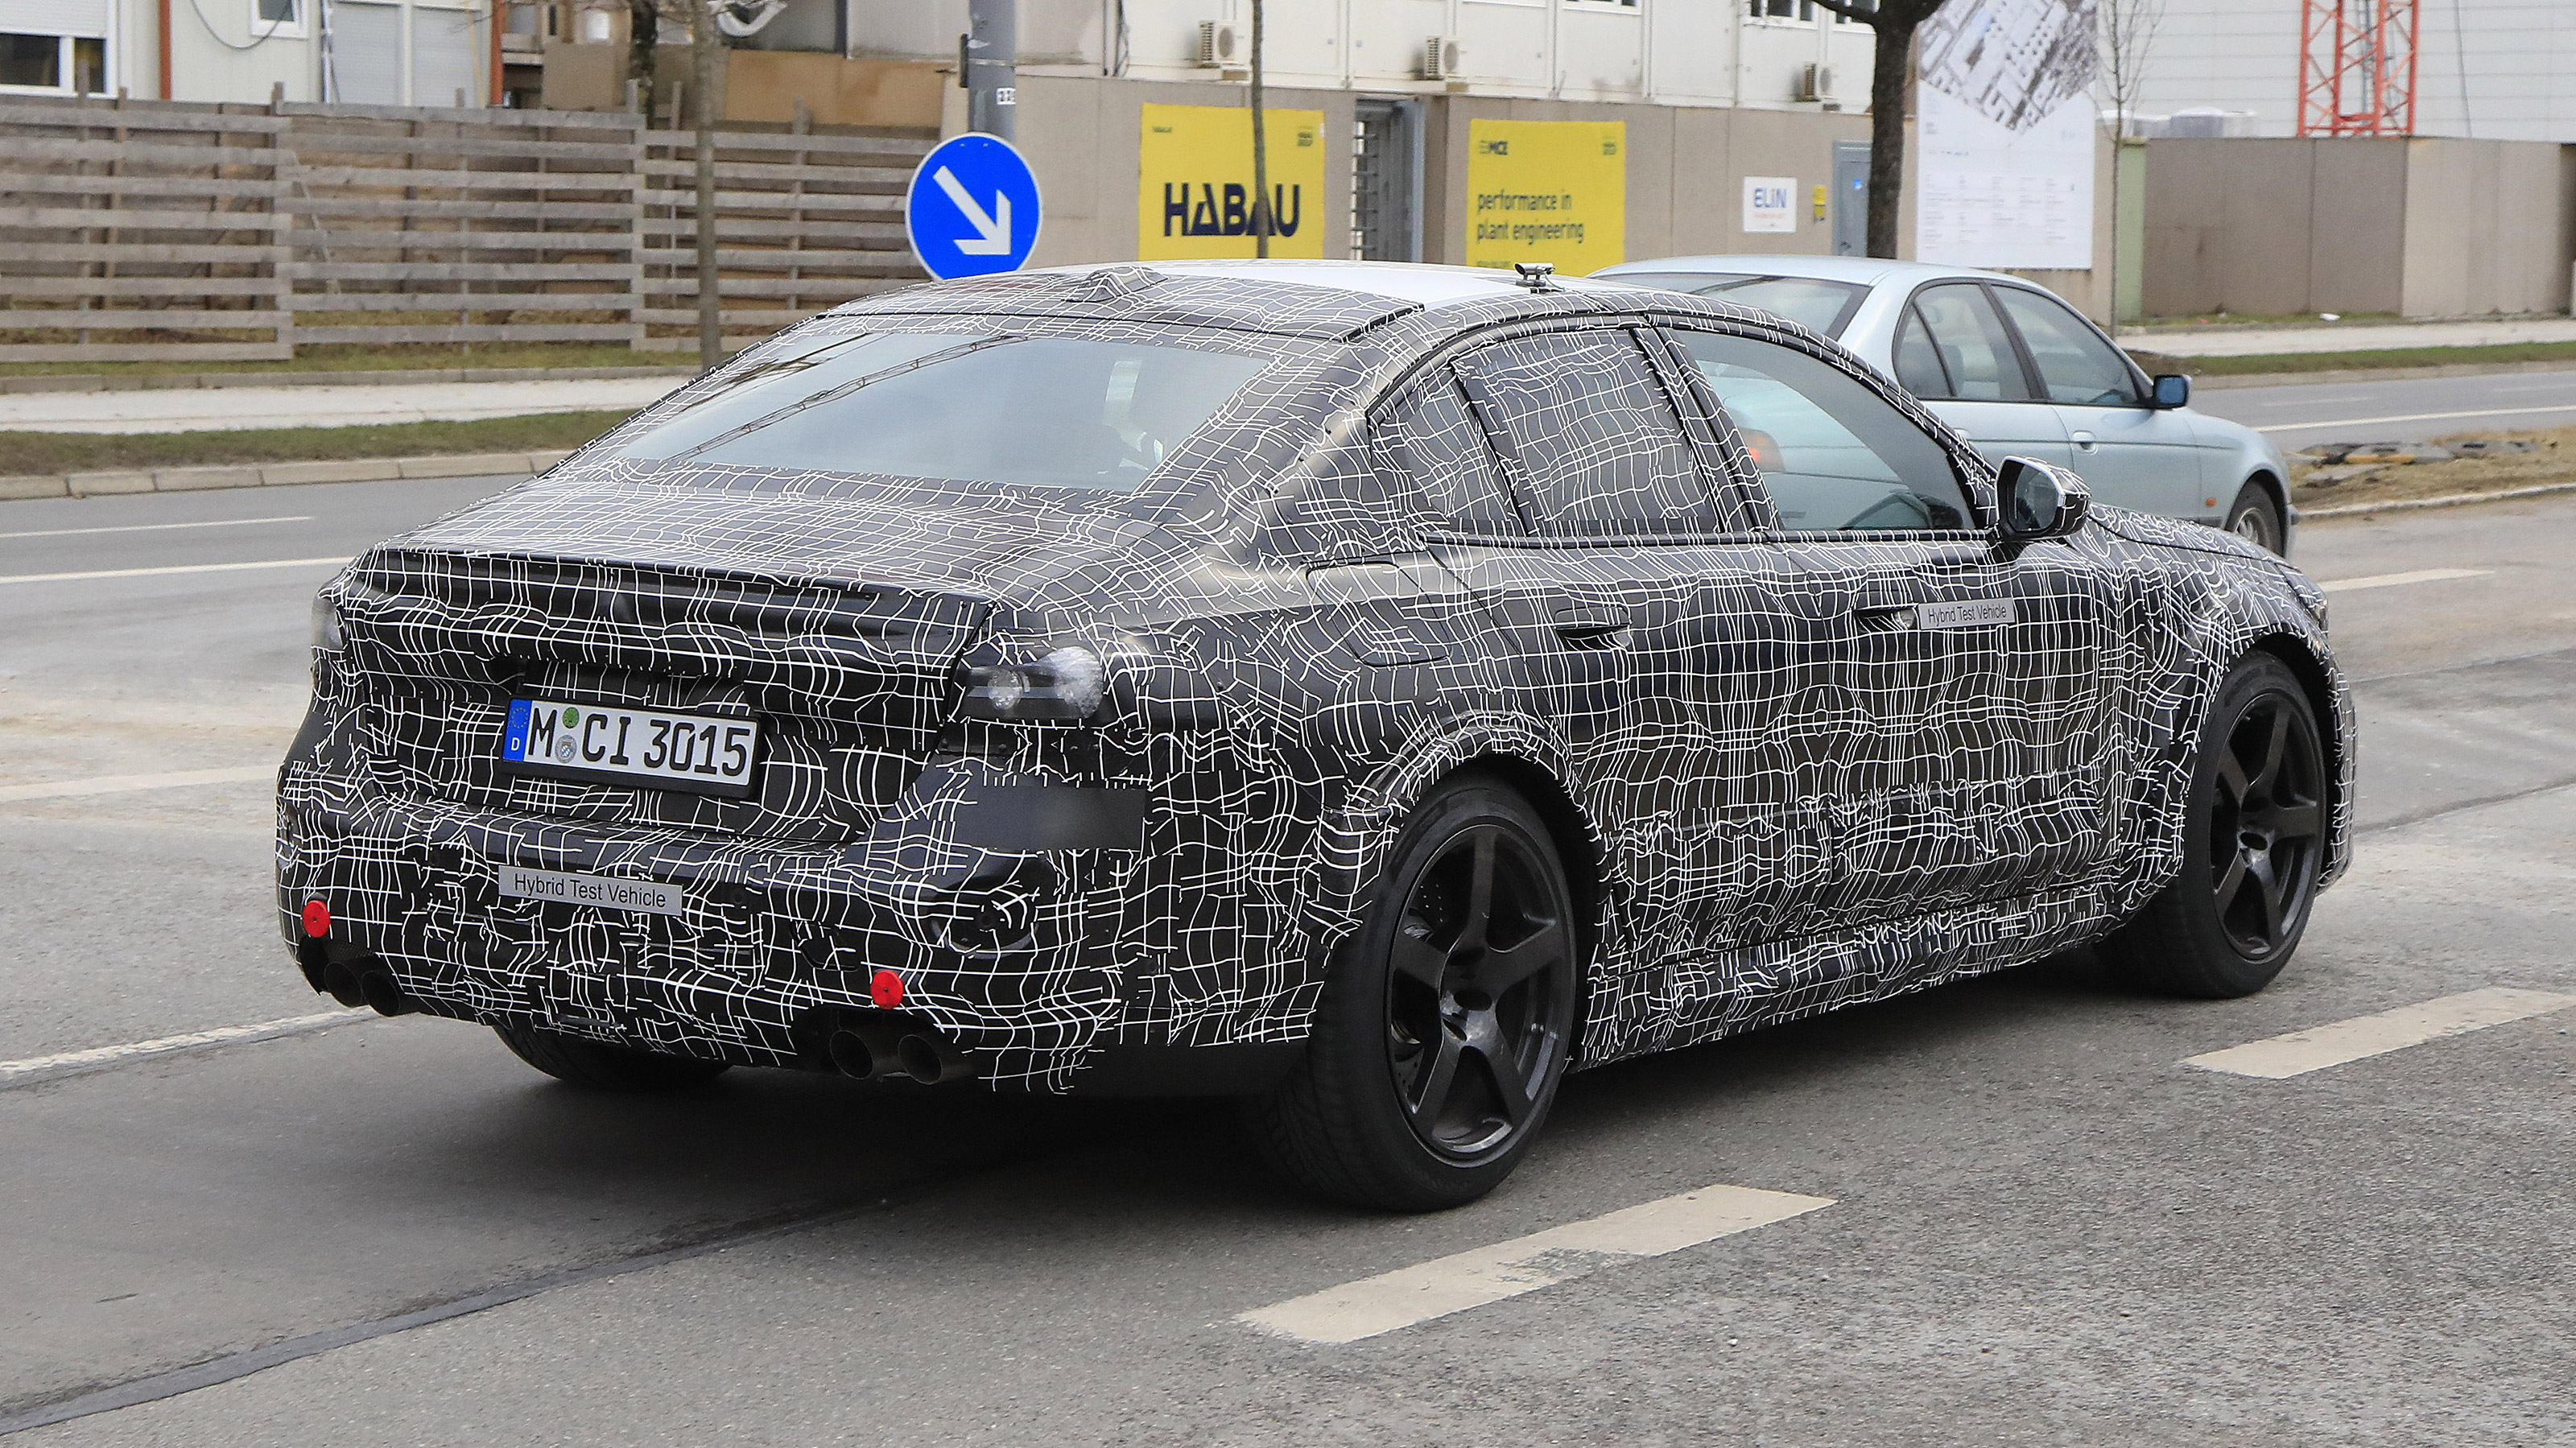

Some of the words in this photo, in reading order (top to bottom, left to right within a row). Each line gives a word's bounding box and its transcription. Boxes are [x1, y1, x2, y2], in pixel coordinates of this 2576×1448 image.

[1164, 182, 1300, 237] HABAU
[1476, 188, 1557, 215] performance
[1560, 188, 1572, 210] in
[1476, 218, 1509, 245] plant
[1513, 218, 1583, 245] engineering
[1928, 606, 1956, 626] Hybrid
[1957, 605, 1976, 621] Test
[1976, 603, 2007, 620] Vehicle
[510, 736, 521, 752] D
[528, 707, 558, 757] M
[582, 713, 631, 765] CI
[644, 720, 751, 777] 3015
[514, 873, 564, 897] Hybrid
[570, 879, 603, 901] Test
[608, 883, 666, 908] Vehicle
